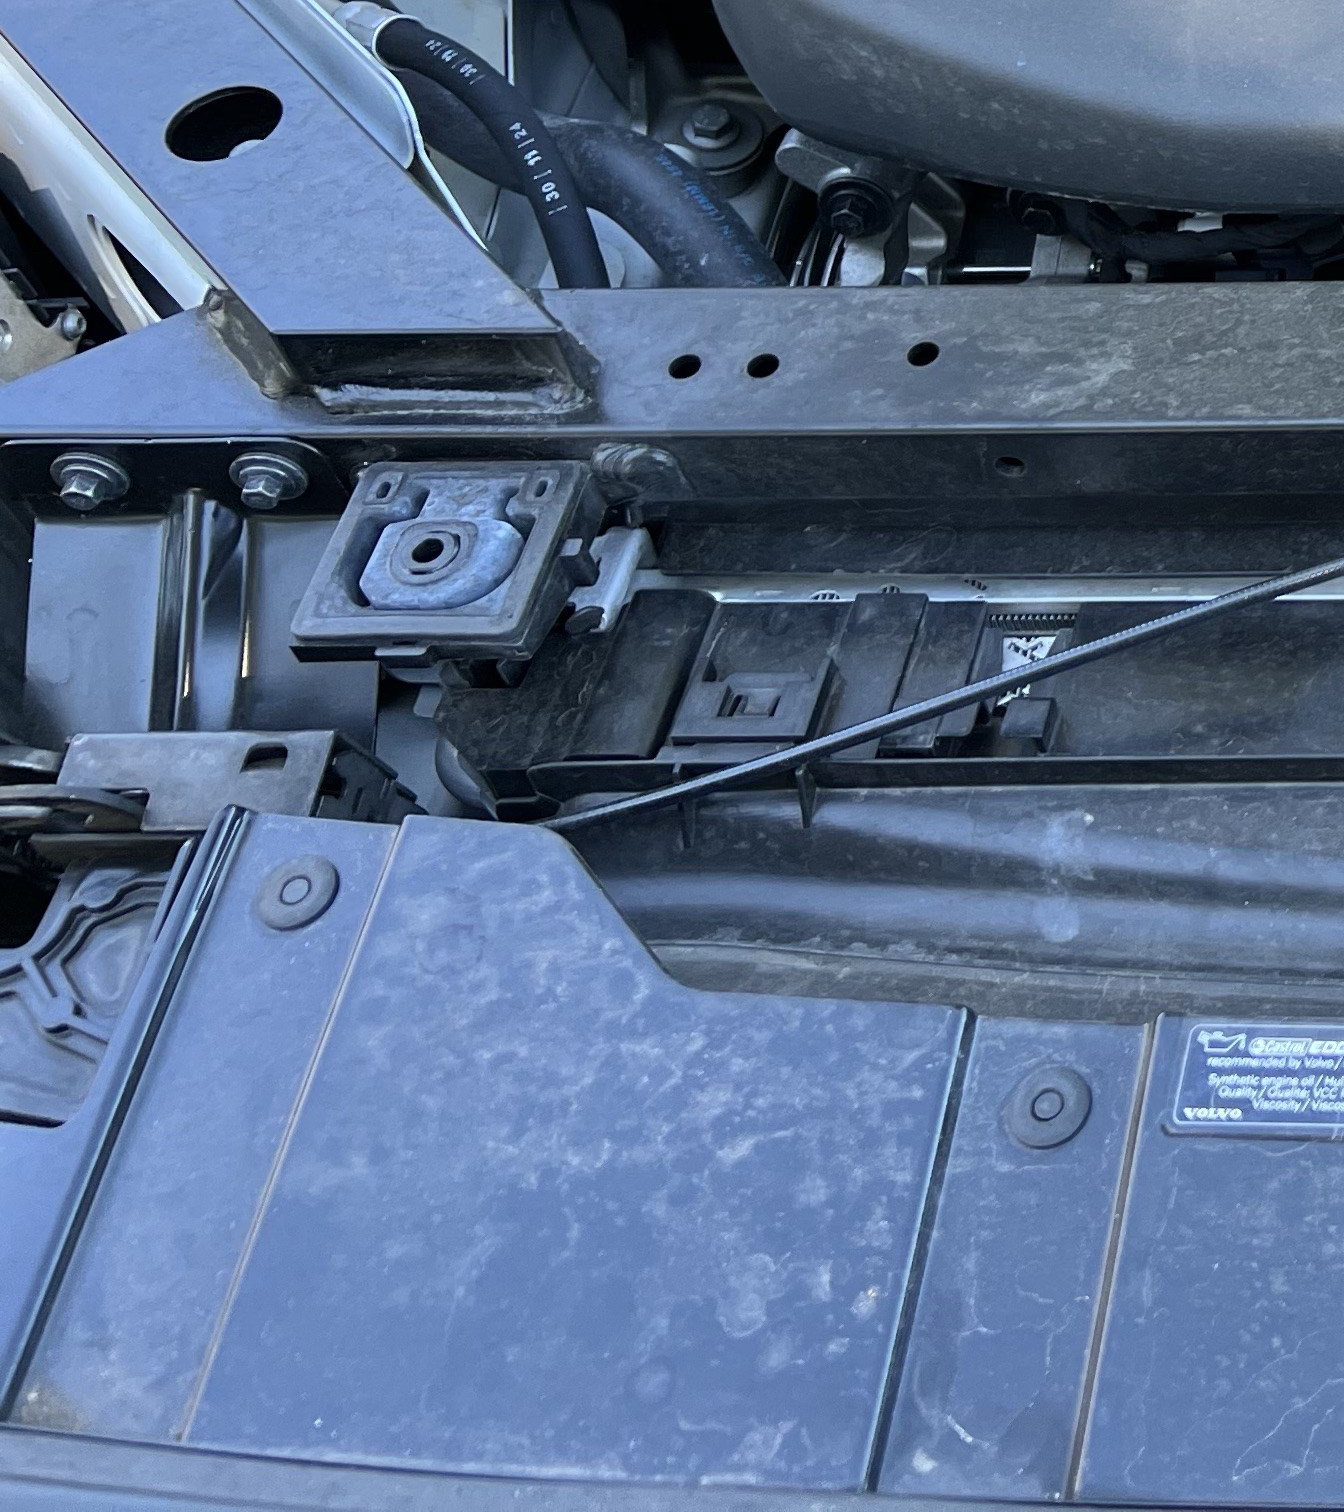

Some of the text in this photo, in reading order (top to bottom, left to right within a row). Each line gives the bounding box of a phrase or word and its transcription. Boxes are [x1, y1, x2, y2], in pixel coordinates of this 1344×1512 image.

[509, 121, 527, 140] 24
[541, 182, 560, 203] 30
[1264, 1039, 1307, 1055] Castrol
[1207, 1056, 1287, 1069] recommended
[1288, 1057, 1303, 1070] by
[1304, 1057, 1334, 1069] Volvo
[1208, 1073, 1261, 1088] Synthetic
[1261, 1076, 1300, 1089] engine
[1301, 1075, 1315, 1087] oil
[1218, 1086, 1258, 1100] Quality
[1314, 1086, 1339, 1100] VCC
[1252, 1099, 1302, 1113] Viscosity
[1183, 1107, 1243, 1121] VOLVO
